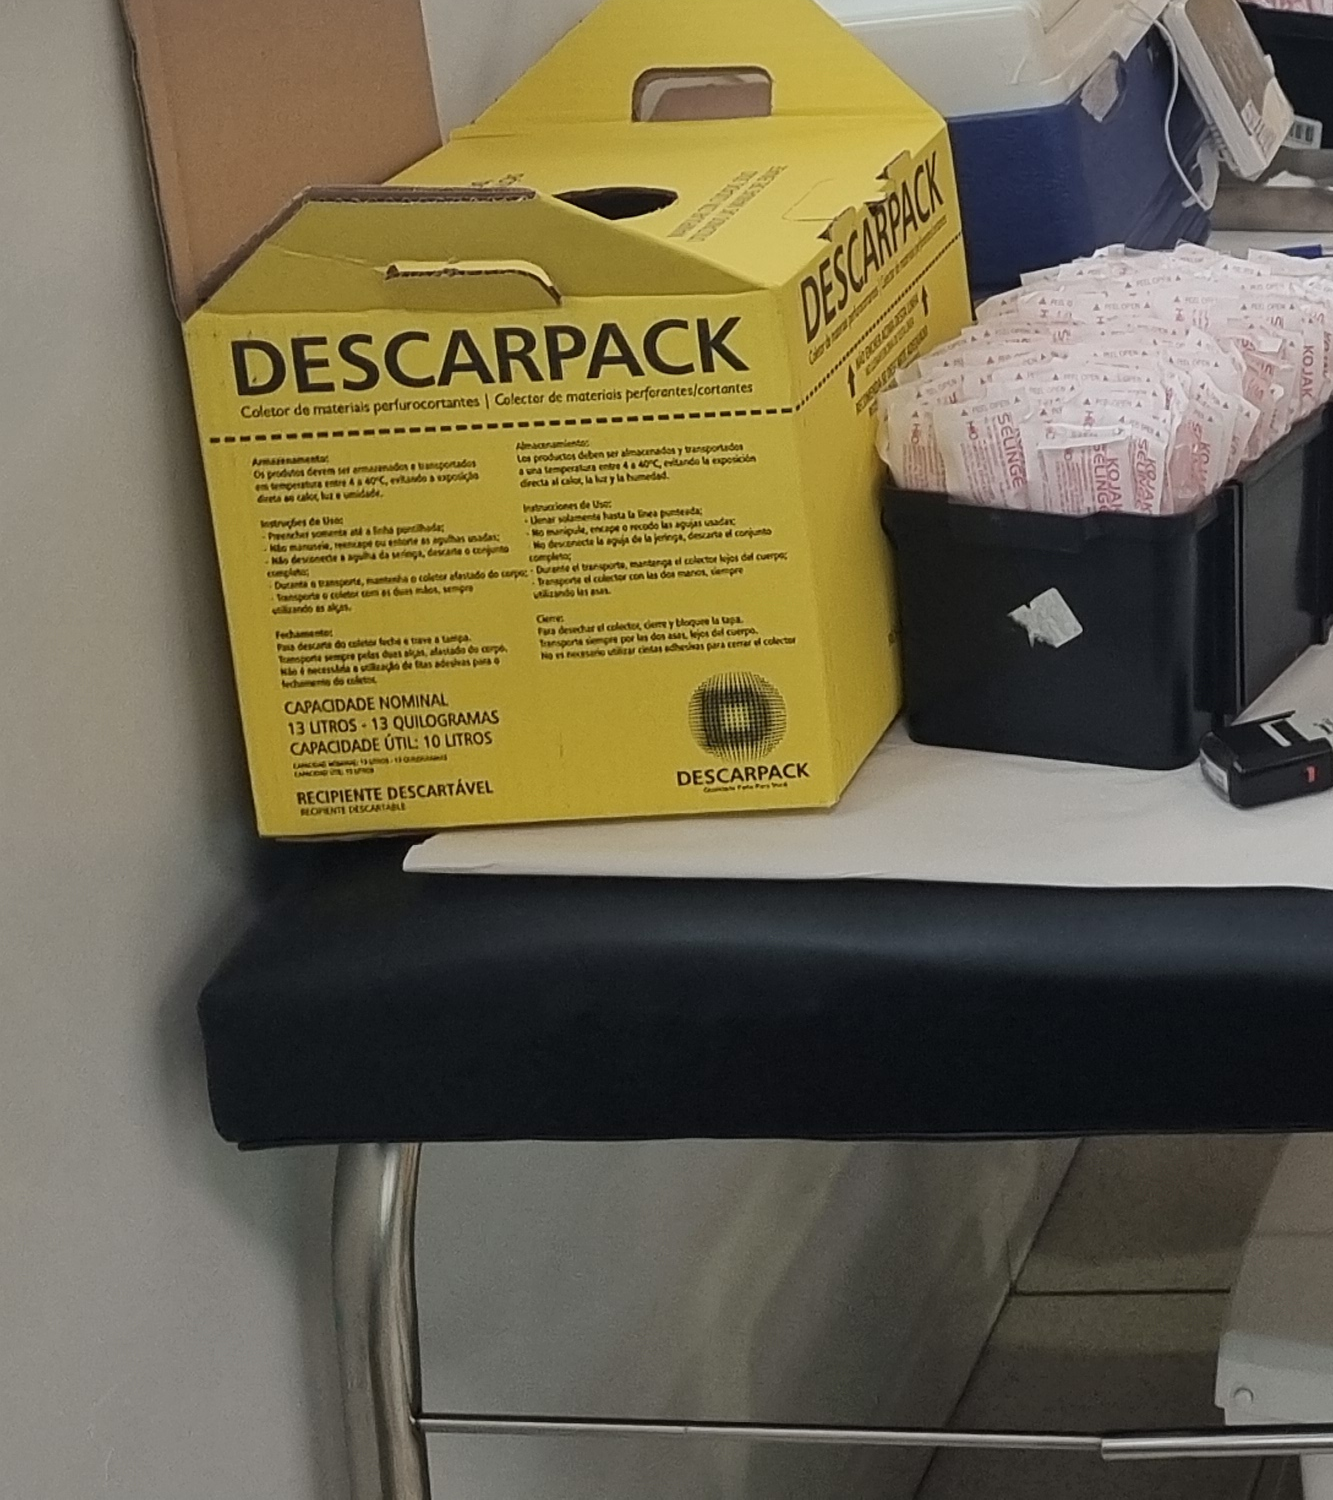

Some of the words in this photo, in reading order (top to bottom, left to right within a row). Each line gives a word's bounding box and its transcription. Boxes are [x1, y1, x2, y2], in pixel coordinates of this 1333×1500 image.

[800, 151, 944, 344] DESCARPACK
[231, 317, 750, 396] DESCARPACK
[1302, 345, 1314, 398] KOJAK
[240, 404, 290, 419] Coletor
[294, 404, 310, 416] de
[314, 400, 370, 415] materiais
[374, 396, 480, 416] perfurocortantes
[494, 393, 544, 406] Colector
[548, 391, 562, 403] de
[566, 388, 622, 402] materiais
[626, 382, 753, 403] perforantes/cortantes
[534, 452, 576, 464] productos
[578, 450, 605, 460] deben
[606, 450, 619, 459] ser
[621, 446, 676, 458] almacenados
[684, 443, 744, 454] transportados
[997, 412, 1026, 488] SELINGE
[544, 462, 597, 476] temperatura
[599, 461, 621, 471] entre
[664, 456, 700, 468] evitando
[712, 454, 756, 467] exposición
[520, 478, 549, 488] directa
[626, 471, 669, 482] humedad.
[1093, 444, 1111, 512] SELING
[558, 512, 601, 523] solamente
[603, 510, 626, 521] hasta
[580, 500, 591, 510] de
[533, 588, 575, 600] utilizando
[541, 650, 554, 660] No
[763, 635, 796, 646] colector
[284, 697, 375, 715] CAPACIDADE
[379, 693, 449, 710] NOMINAL
[287, 721, 305, 736] 13
[309, 718, 358, 734] LITROS
[372, 717, 388, 731] 13
[393, 710, 500, 731] QUILOGRAMAS
[290, 737, 380, 756] CAPACIDADE
[385, 733, 420, 751] ÚTIL:
[424, 735, 441, 749] 10
[445, 731, 493, 748] LITROS
[677, 762, 810, 786] DESCARPACK
[296, 787, 383, 805] RECIPIENTE
[387, 779, 494, 800] DESCARTÁVEL
[300, 806, 346, 816] RECIPIENTE
[348, 802, 406, 814] DESCARTABLE
